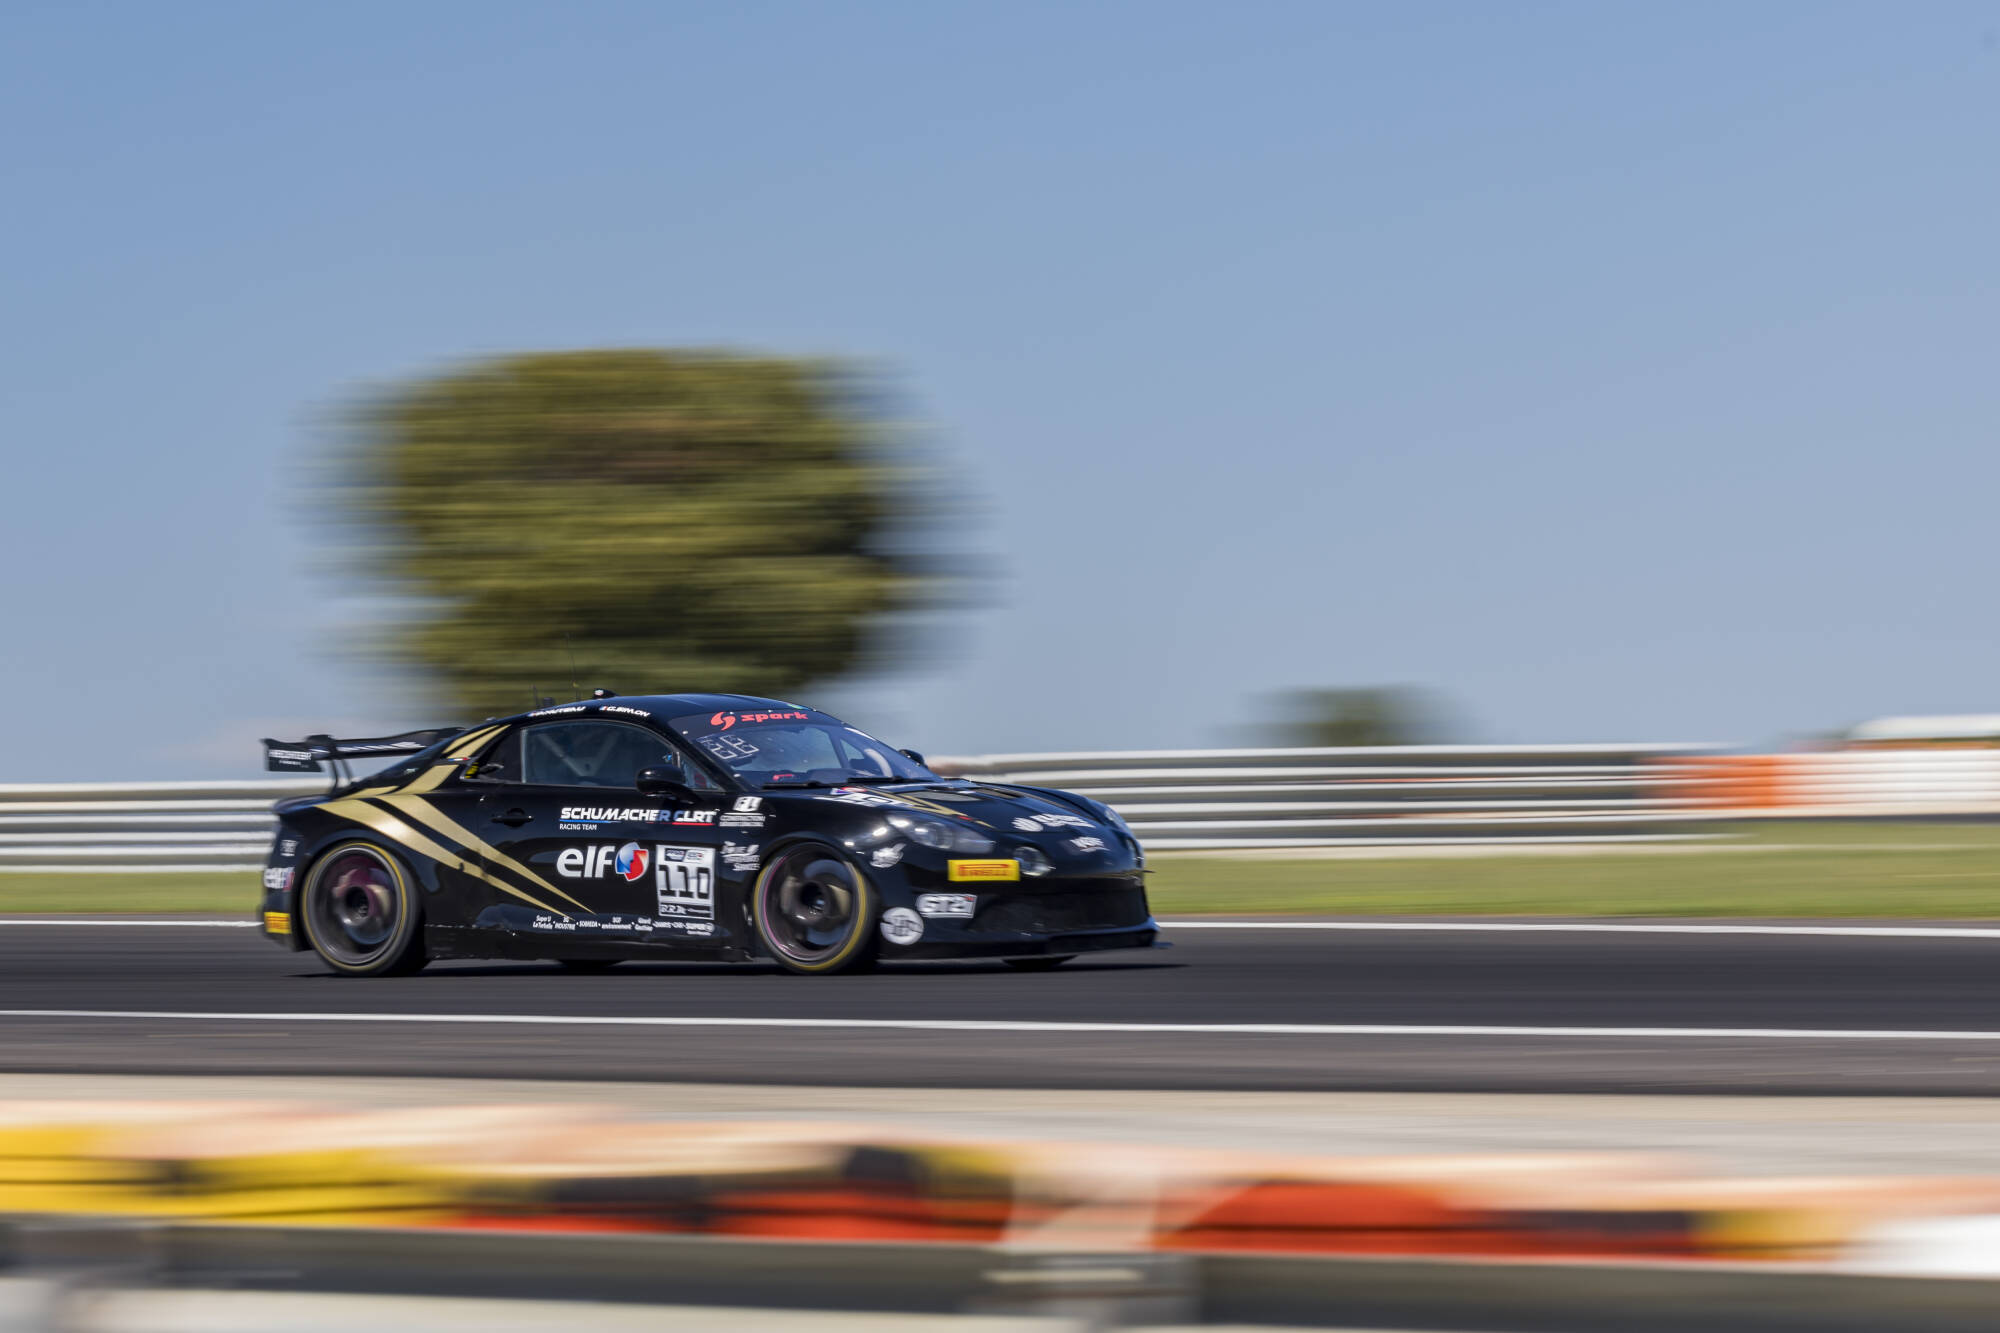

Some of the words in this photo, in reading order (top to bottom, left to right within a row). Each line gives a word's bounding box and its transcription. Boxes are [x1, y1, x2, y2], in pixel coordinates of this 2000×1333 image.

[740, 711, 808, 723] spark
[560, 807, 671, 822] SCHUMACHER
[673, 809, 717, 823] CLRT
[559, 823, 581, 831] RACING
[582, 823, 598, 831] TEAM
[556, 845, 616, 878] elf
[658, 864, 711, 900] 110
